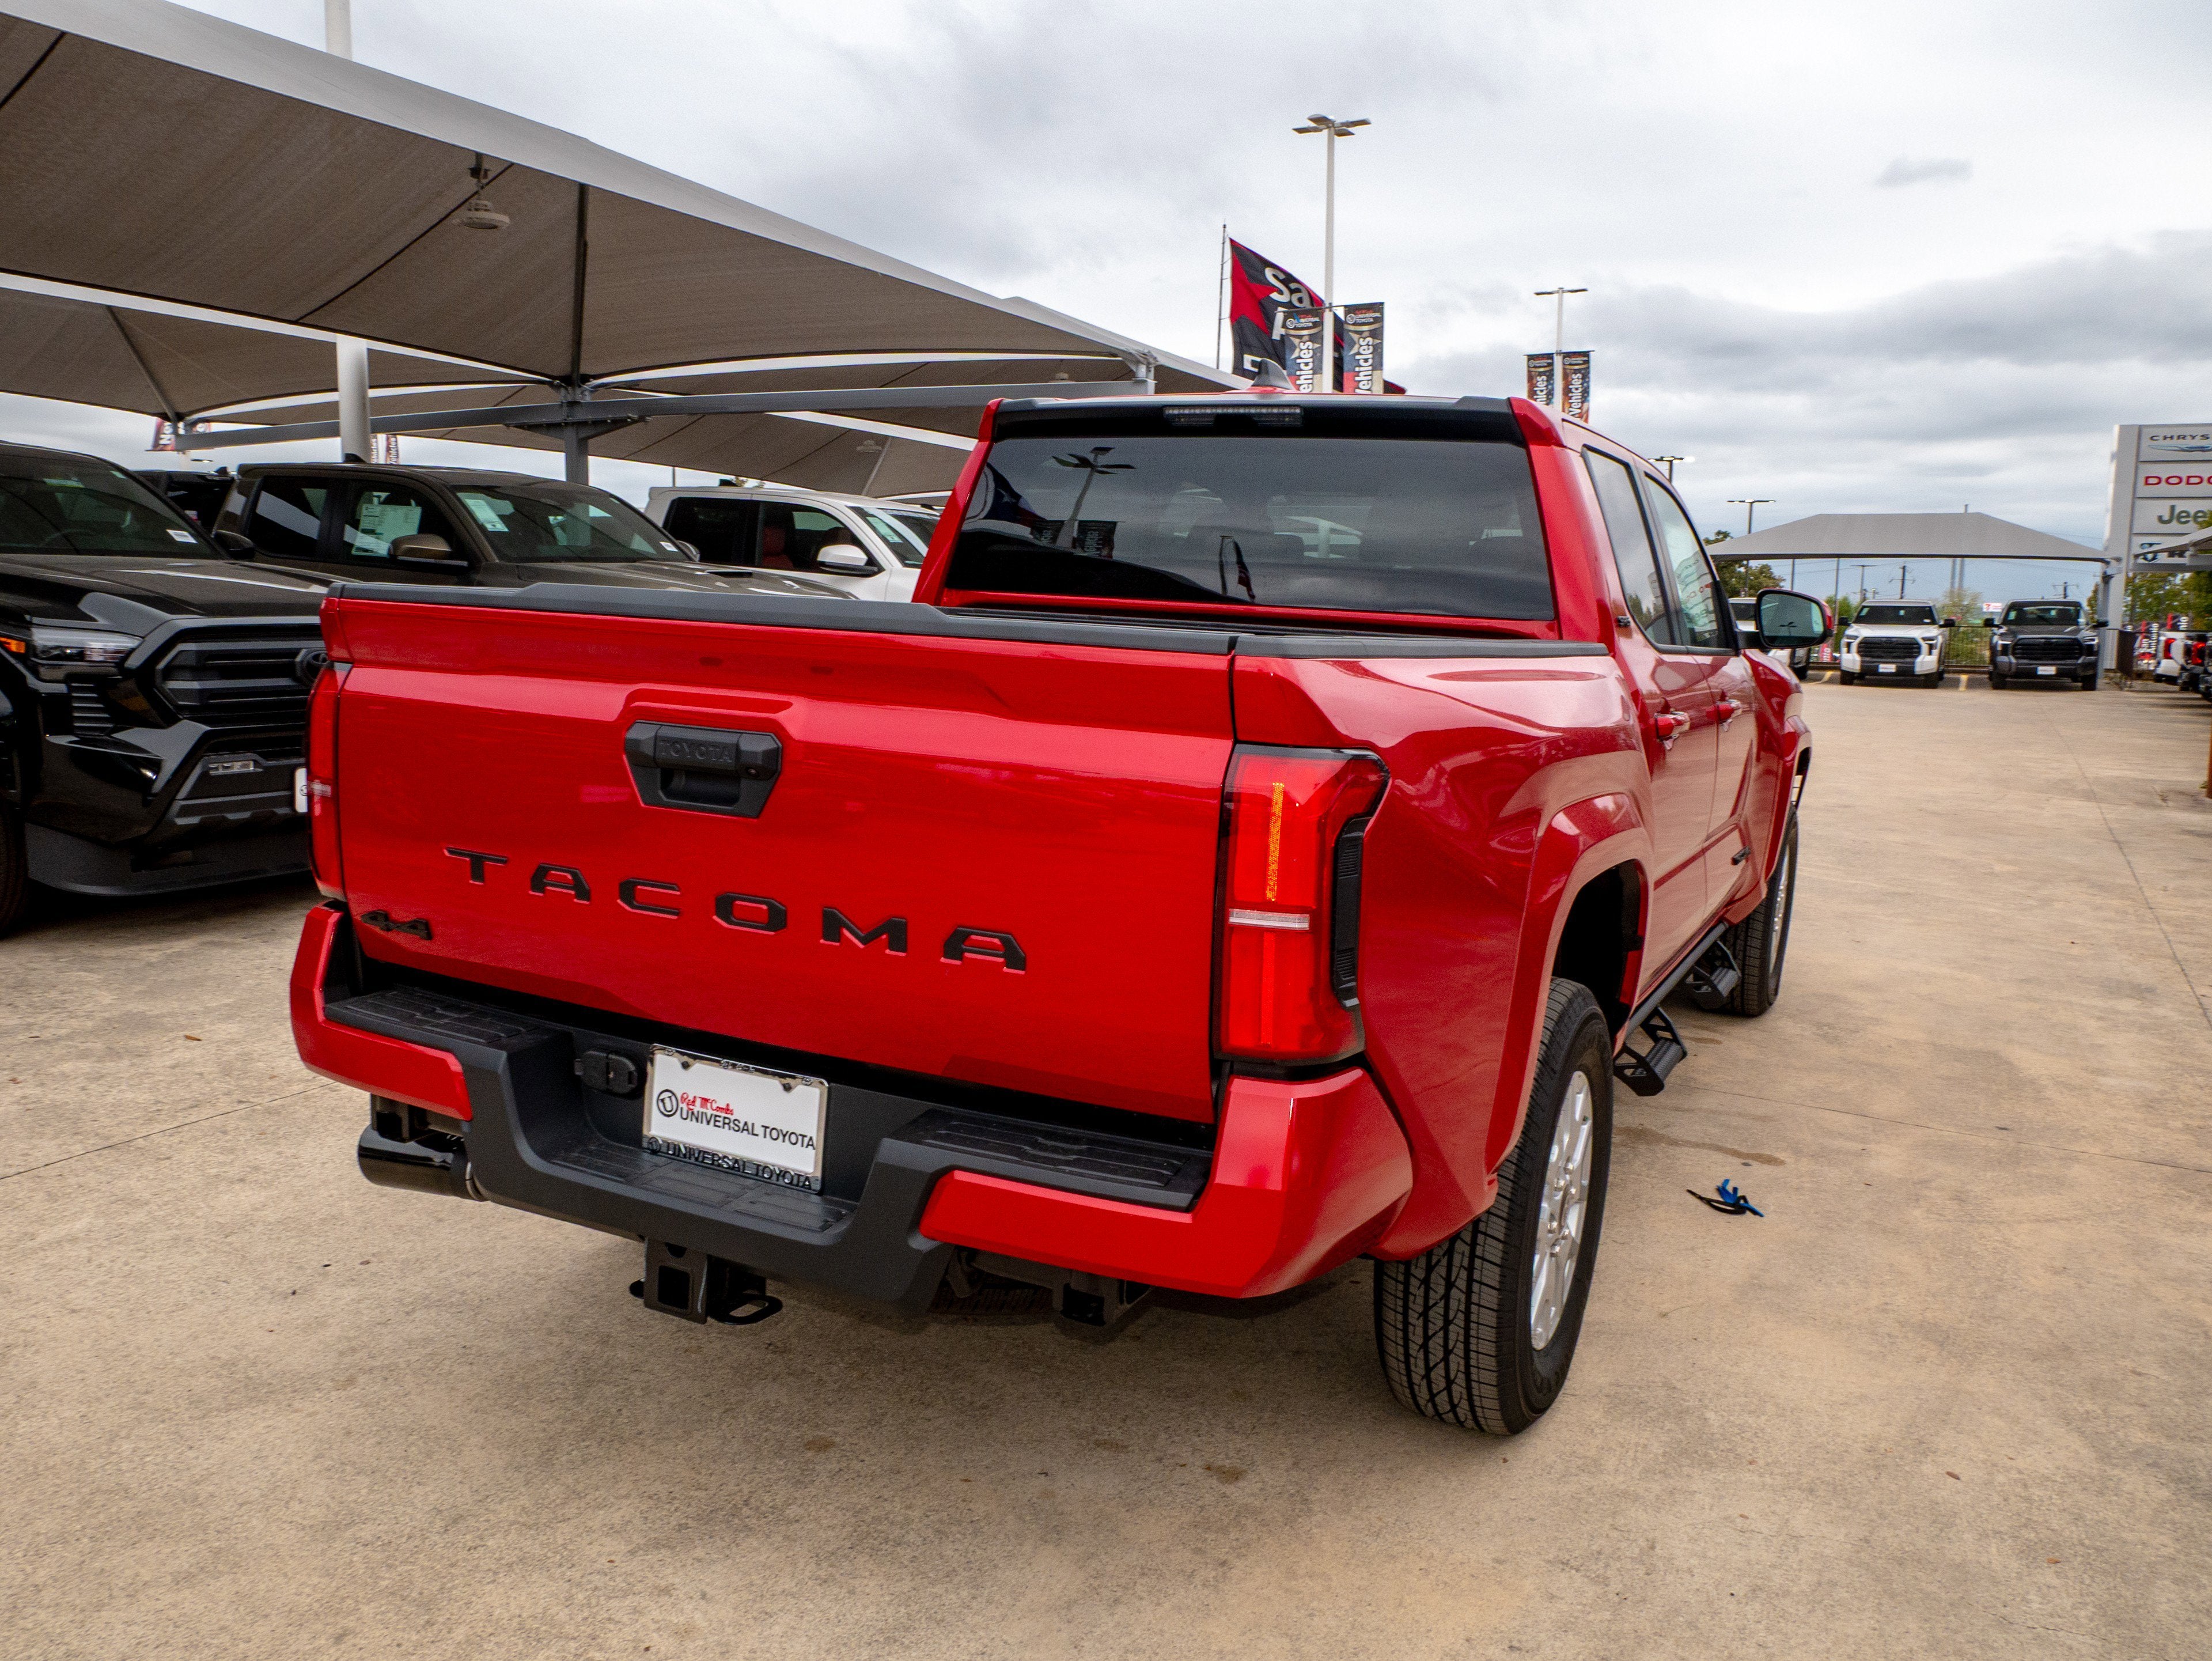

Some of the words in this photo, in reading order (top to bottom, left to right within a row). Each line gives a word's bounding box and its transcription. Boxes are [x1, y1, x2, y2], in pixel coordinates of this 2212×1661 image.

[659, 739, 733, 762] TOYOTA
[444, 847, 1027, 974] TACOMA
[680, 1107, 759, 1137] UNIVERSAL
[762, 1125, 816, 1150] TOYOTA
[668, 1141, 752, 1173] UNIVERSAL
[753, 1161, 812, 1190] TOYOTA
